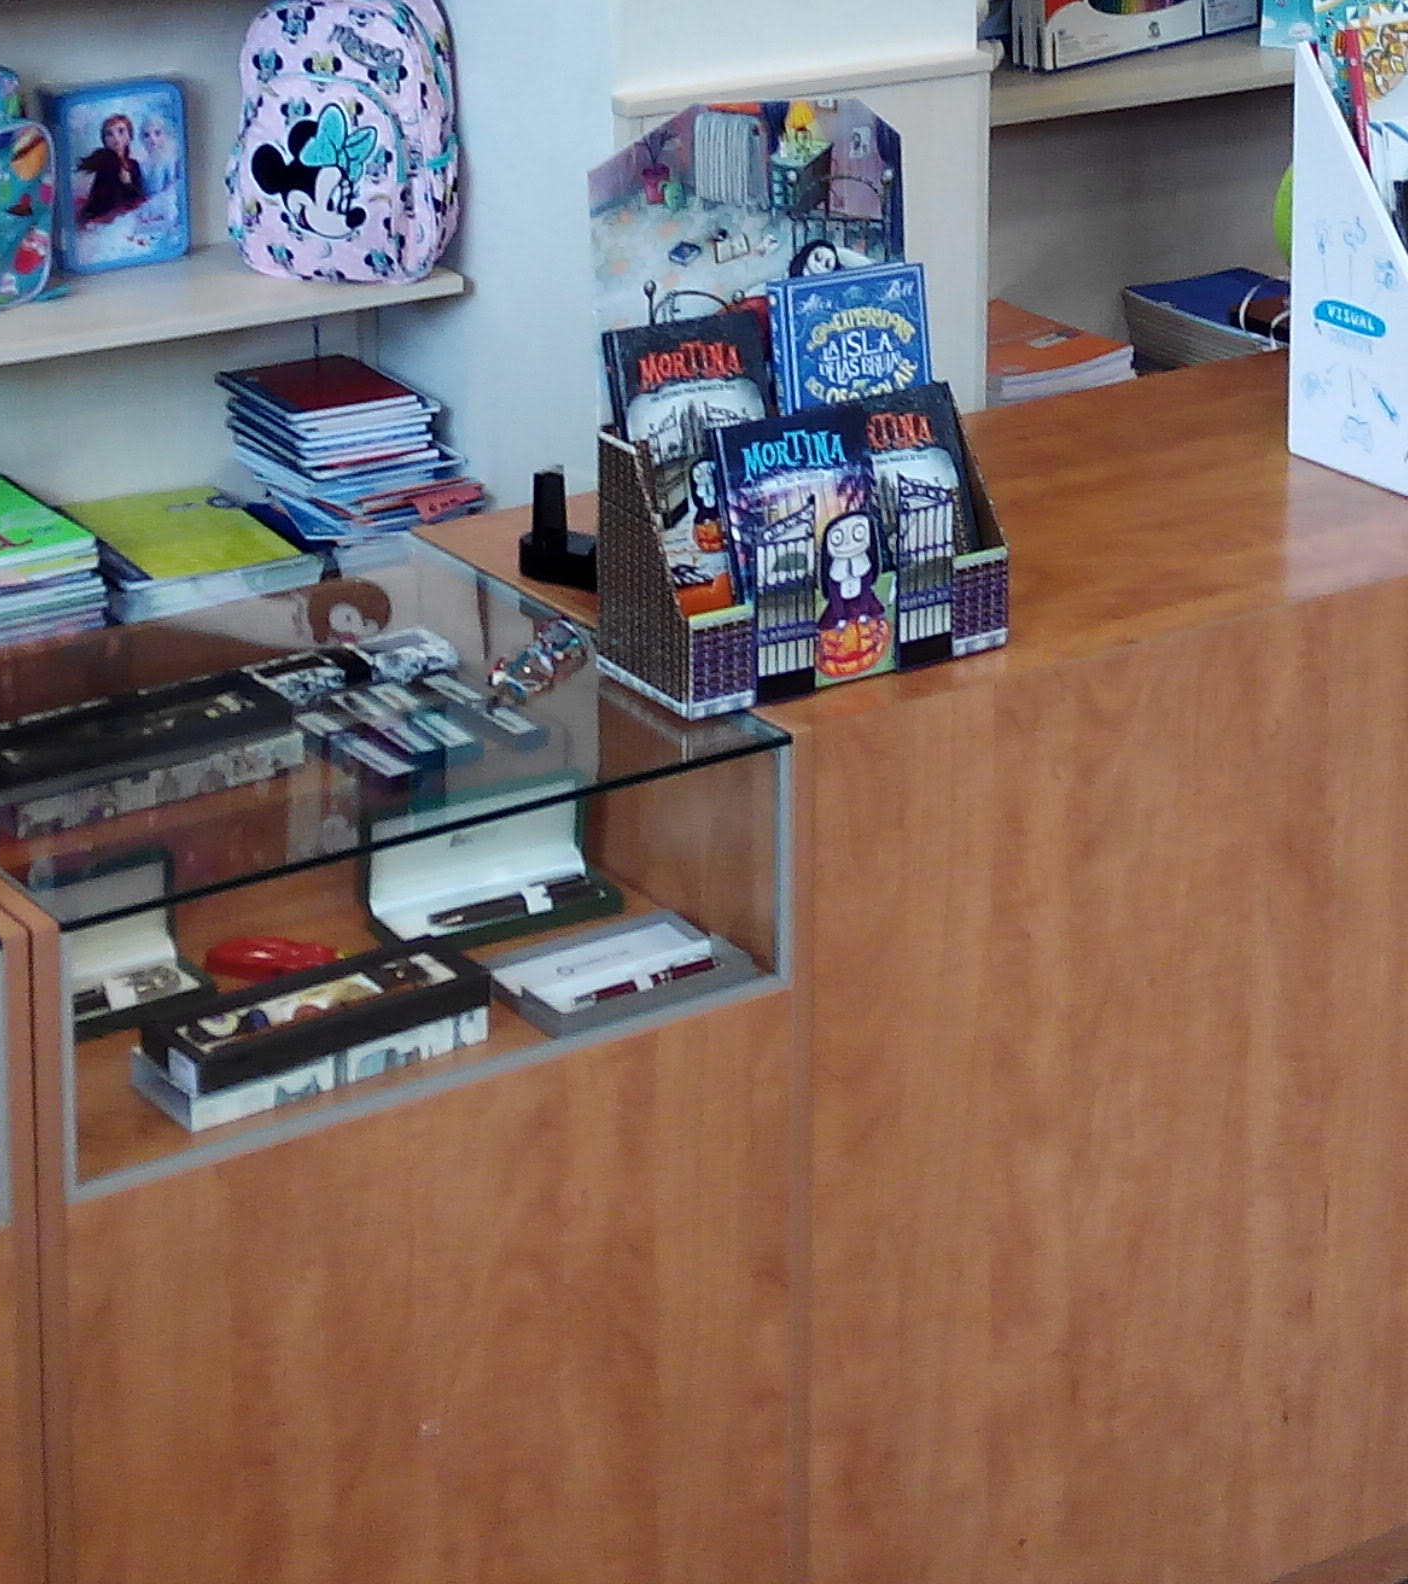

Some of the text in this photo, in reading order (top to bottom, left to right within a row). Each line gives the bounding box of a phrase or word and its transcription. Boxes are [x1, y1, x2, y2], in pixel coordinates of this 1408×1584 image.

[1327, 302, 1376, 331] VISUAL
[823, 340, 840, 362] LA
[842, 328, 893, 358] ISLA
[637, 337, 746, 393] MORTINA
[836, 358, 860, 386] LAS
[741, 428, 848, 483] MORTINA
